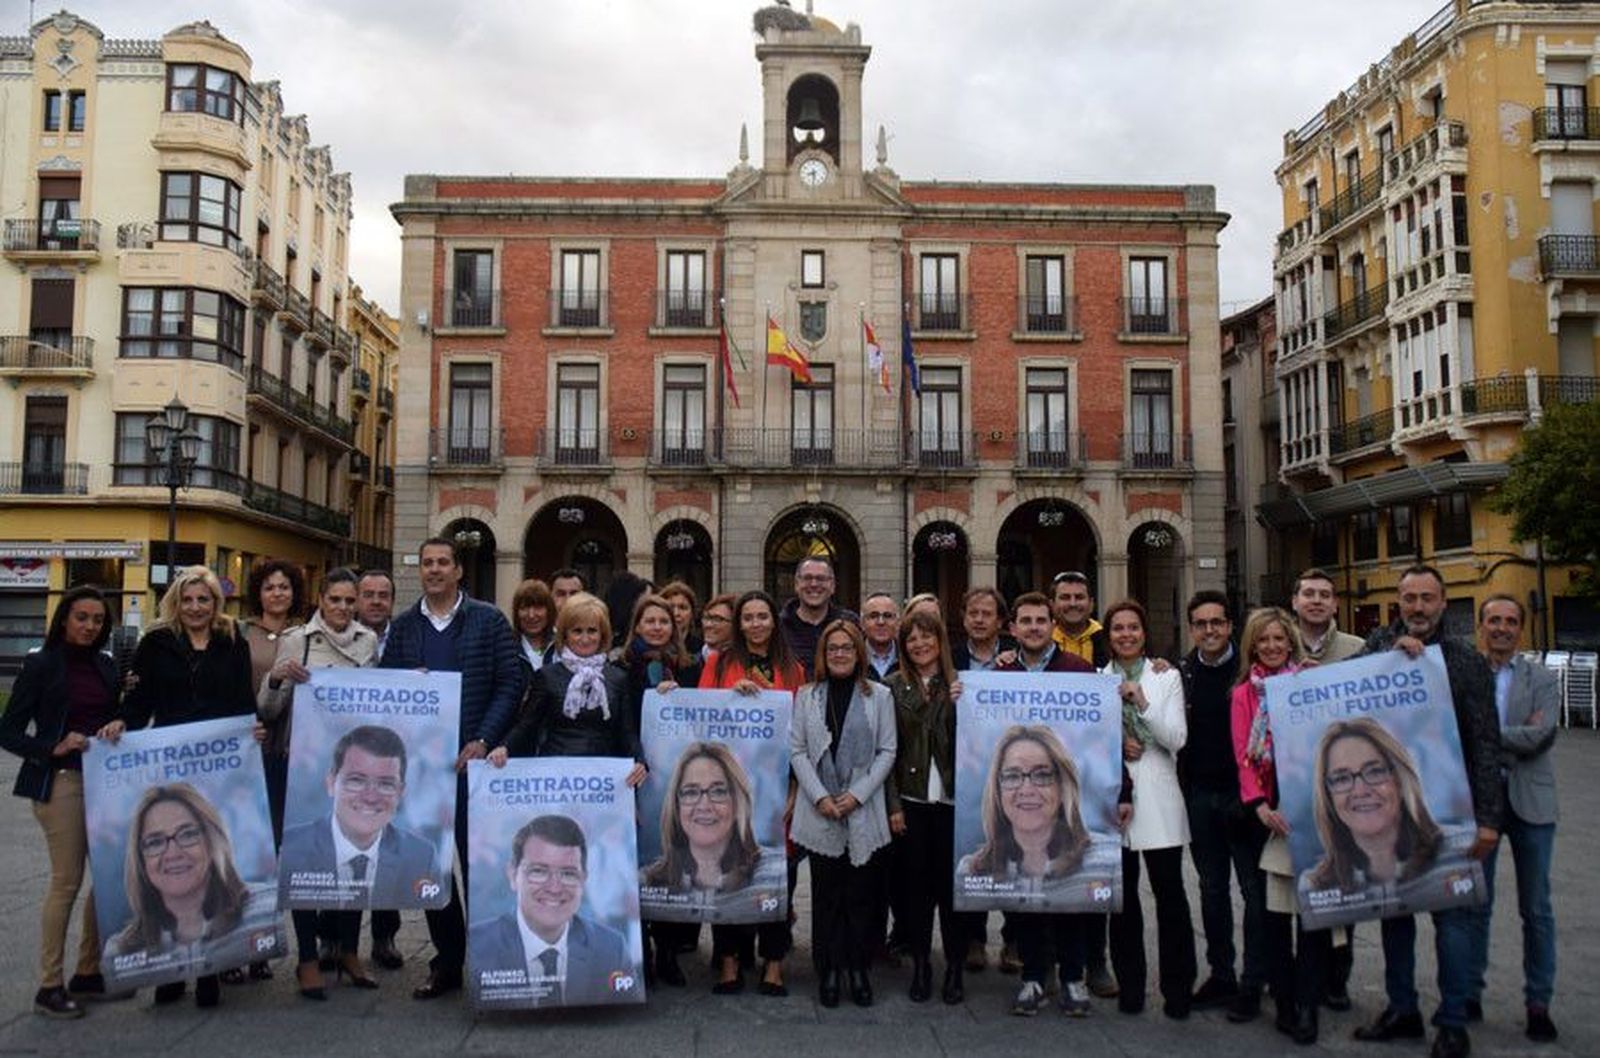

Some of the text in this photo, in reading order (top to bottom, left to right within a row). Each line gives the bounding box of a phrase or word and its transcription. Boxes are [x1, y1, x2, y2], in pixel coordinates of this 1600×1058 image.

[314, 687, 440, 704] CENTRADOS
[1288, 669, 1424, 707] CENTRADOS
[976, 689, 1102, 706] CENTRADOS
[1345, 689, 1428, 714] FUTURO
[329, 703, 391, 714] CASTILLA
[392, 705, 403, 714] Y
[404, 704, 440, 716] LEÓN
[660, 707, 775, 723] CENTRADOS
[975, 707, 994, 719] EN
[1028, 707, 1102, 722] FUTURO
[708, 725, 774, 739] FUTURO
[105, 737, 240, 771] CENTRADOS
[164, 755, 242, 779] FUTURO
[489, 776, 615, 794] CENTRADOS
[506, 794, 568, 806] CASTILLA
[568, 794, 579, 804] Y
[580, 791, 614, 804] LEÓN
